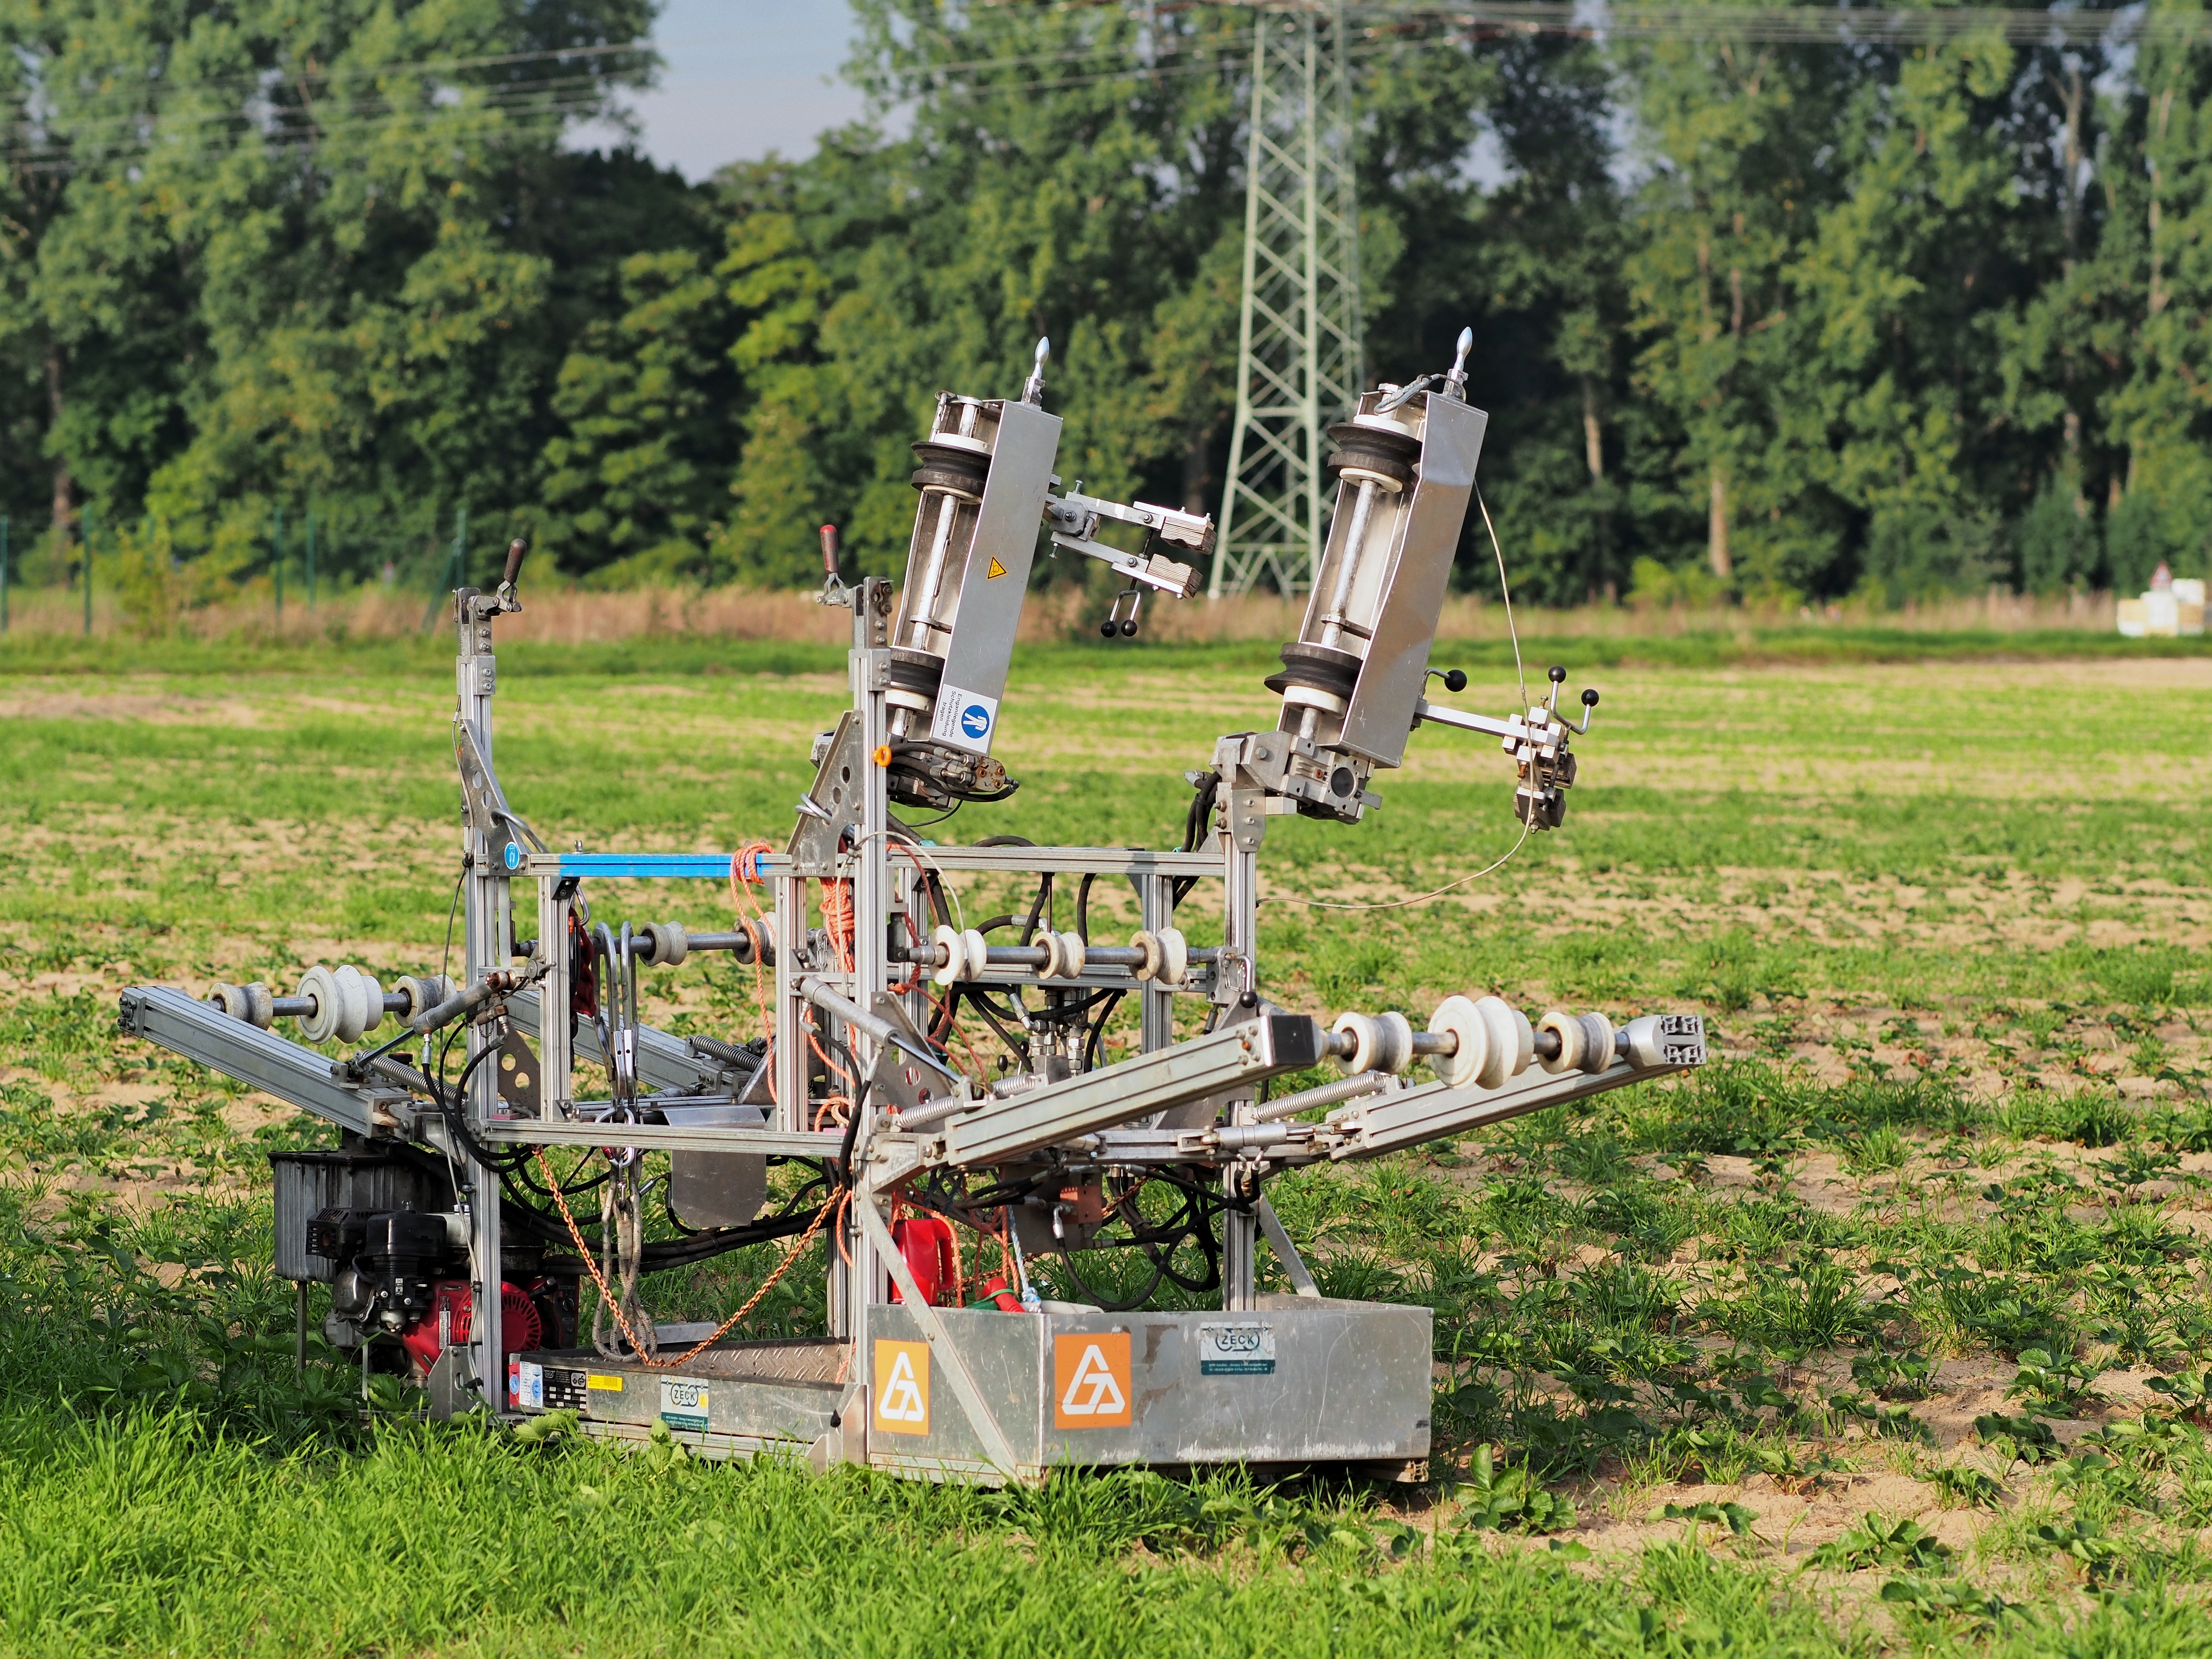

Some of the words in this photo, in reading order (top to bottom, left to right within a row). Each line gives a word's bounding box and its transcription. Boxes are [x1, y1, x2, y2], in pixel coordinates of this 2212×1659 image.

[942, 690, 956, 737] Schutzkleidung
[949, 694, 962, 738] Enganliegende
[1221, 1334, 1255, 1345] ZECK
[674, 1389, 696, 1401] ZECK
